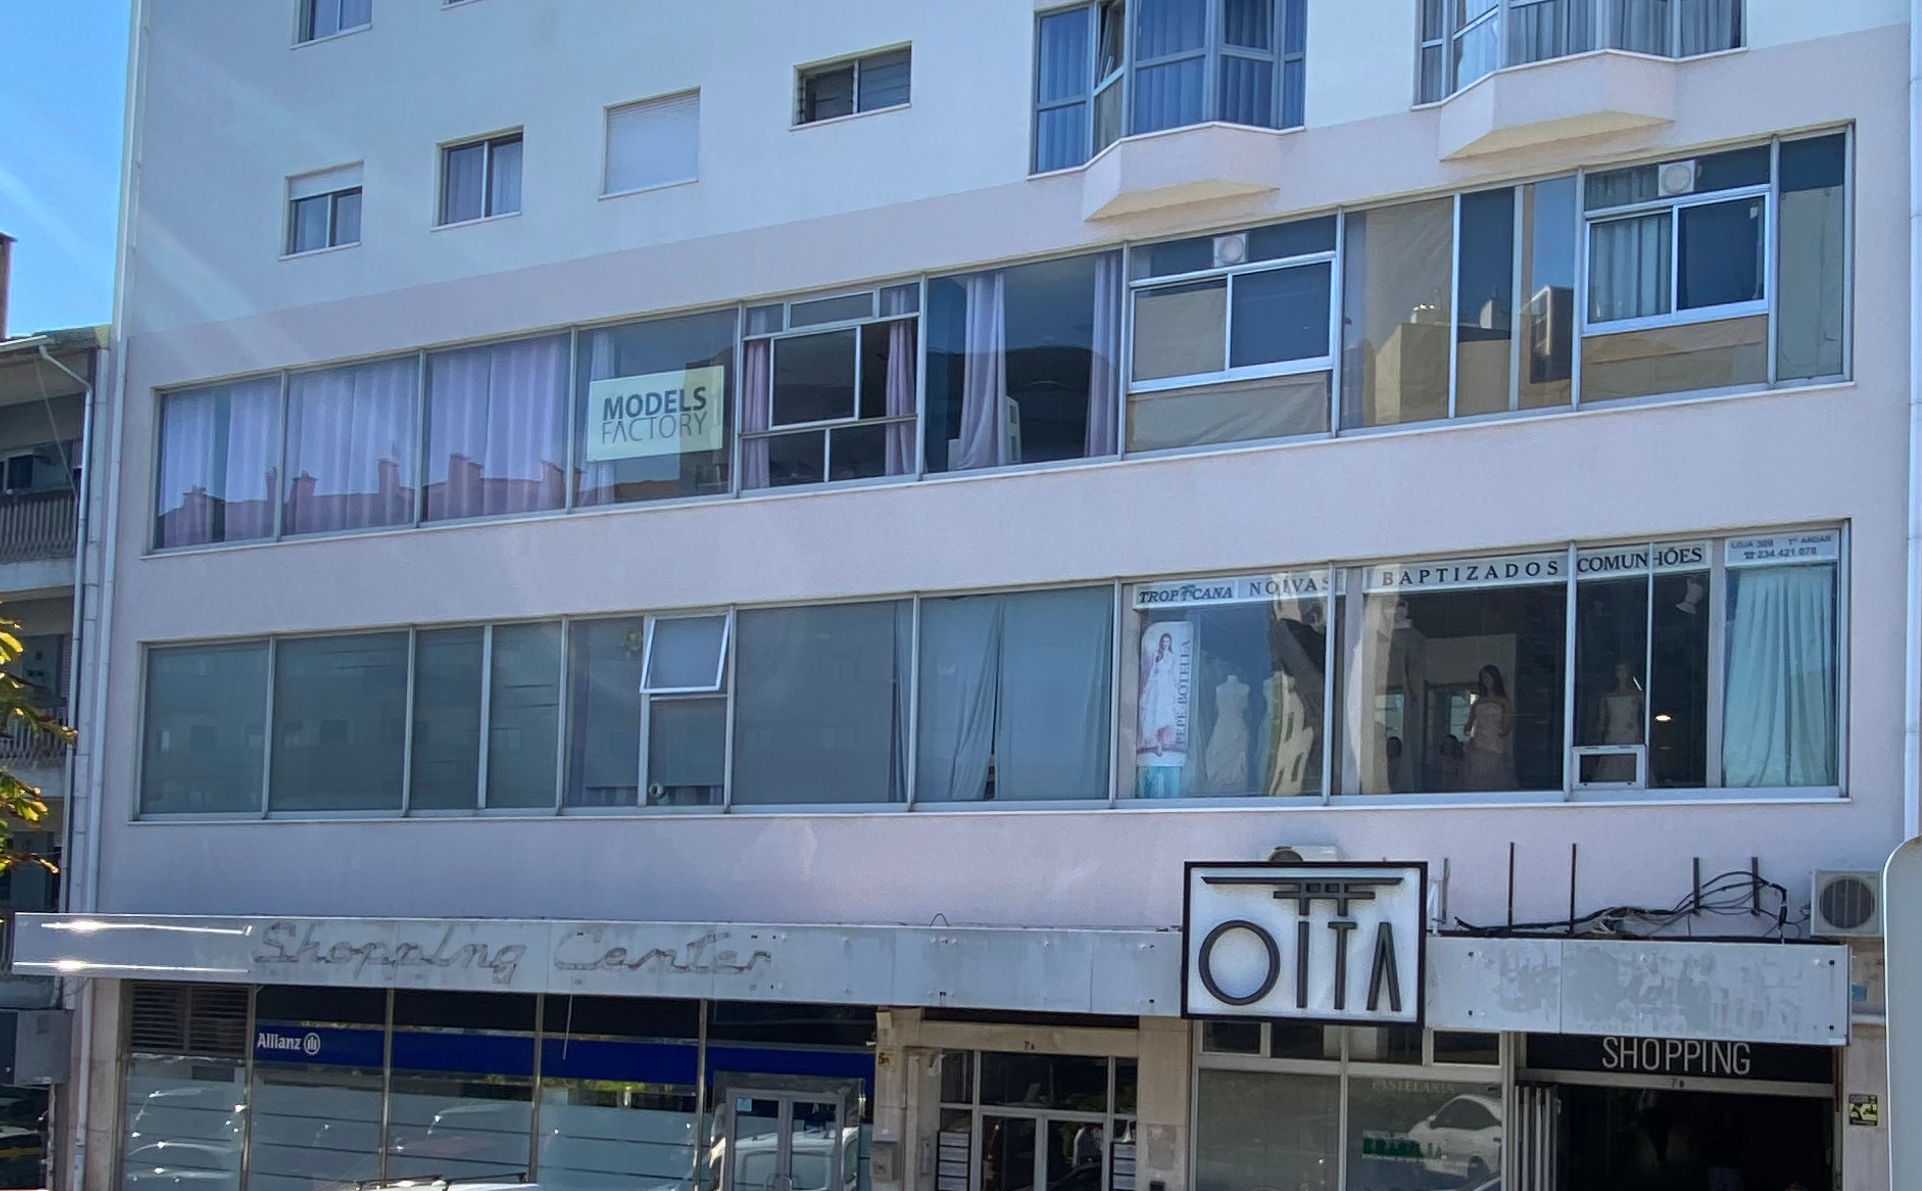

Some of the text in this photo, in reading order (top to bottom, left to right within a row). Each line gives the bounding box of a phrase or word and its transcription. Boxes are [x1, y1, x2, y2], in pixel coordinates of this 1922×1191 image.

[603, 386, 707, 421] MODELS
[602, 411, 707, 445] FACTORY
[1577, 547, 1703, 573] COMUNHÕES
[1778, 548, 1796, 557] 421
[1382, 560, 1558, 587] BAPTIZADOS
[256, 1032, 302, 1051] Allianz
[1602, 1036, 1751, 1076] SHOPPING
